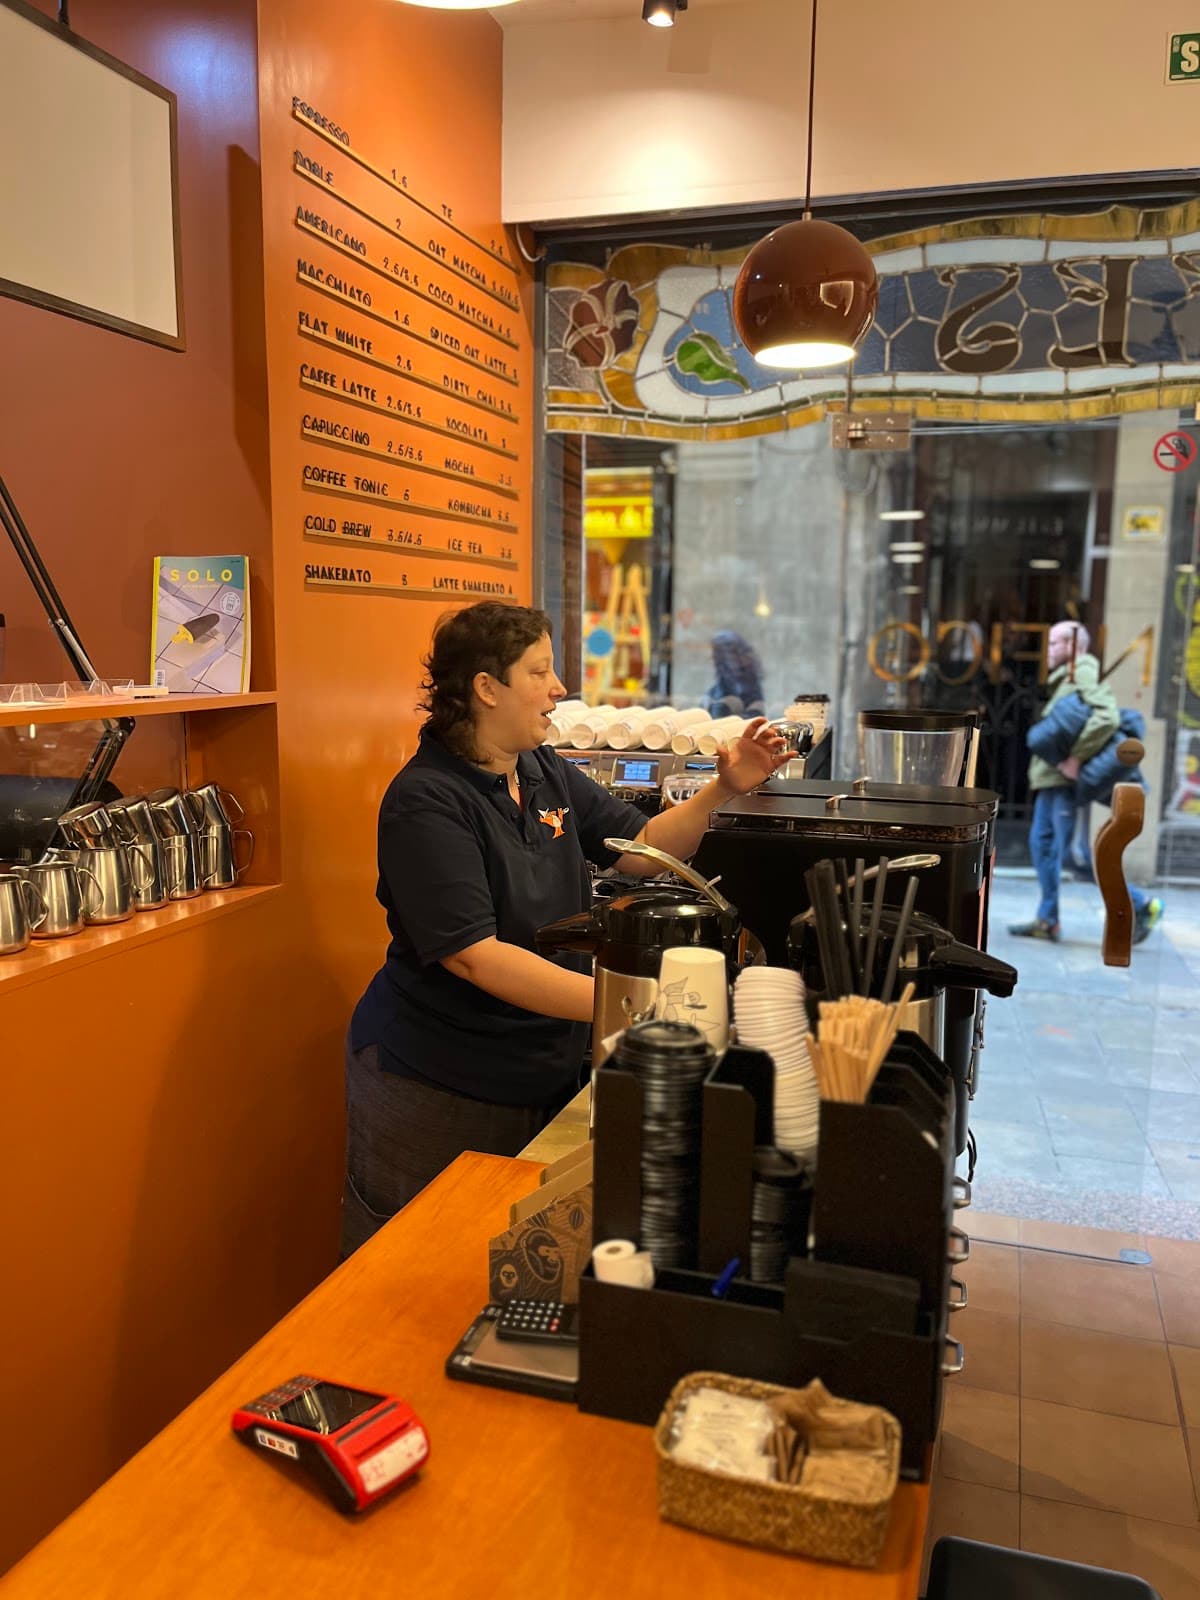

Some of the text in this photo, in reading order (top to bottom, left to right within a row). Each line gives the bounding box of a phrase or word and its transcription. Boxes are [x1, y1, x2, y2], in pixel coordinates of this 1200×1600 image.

[292, 96, 350, 146] ESPRESSO
[294, 150, 334, 184] DOBLE
[297, 206, 366, 256] AMERICANO
[428, 240, 446, 258] OAT
[453, 256, 486, 284] MATCHA
[297, 258, 372, 306] MACCHIATO
[428, 283, 454, 306] COCO
[458, 300, 494, 329] MATCHA
[298, 312, 328, 335] FLAT
[336, 328, 374, 354] WHITE
[430, 326, 460, 351] SPICED
[464, 344, 480, 360] OAT
[485, 354, 507, 374] LATTE
[300, 364, 337, 388] CAFFE
[342, 378, 376, 402] LATTE
[443, 374, 470, 395] DIRTY
[477, 390, 496, 406] CHAI
[303, 414, 370, 446] CAPUCCINO
[446, 416, 488, 442] XOCOLATA
[304, 465, 346, 488] COFFEE
[354, 476, 388, 496] TONIC
[445, 458, 475, 476] MOCHA
[448, 498, 492, 518] KOMBUCHA
[304, 515, 336, 532] COLD
[342, 521, 372, 538] BREW
[448, 538, 462, 552] ICE
[468, 542, 482, 554] TEA
[170, 569, 233, 581] SOLO
[304, 564, 372, 583] SHAKERATO
[433, 576, 458, 590] LATTE
[462, 579, 504, 594] SHAKERATO
